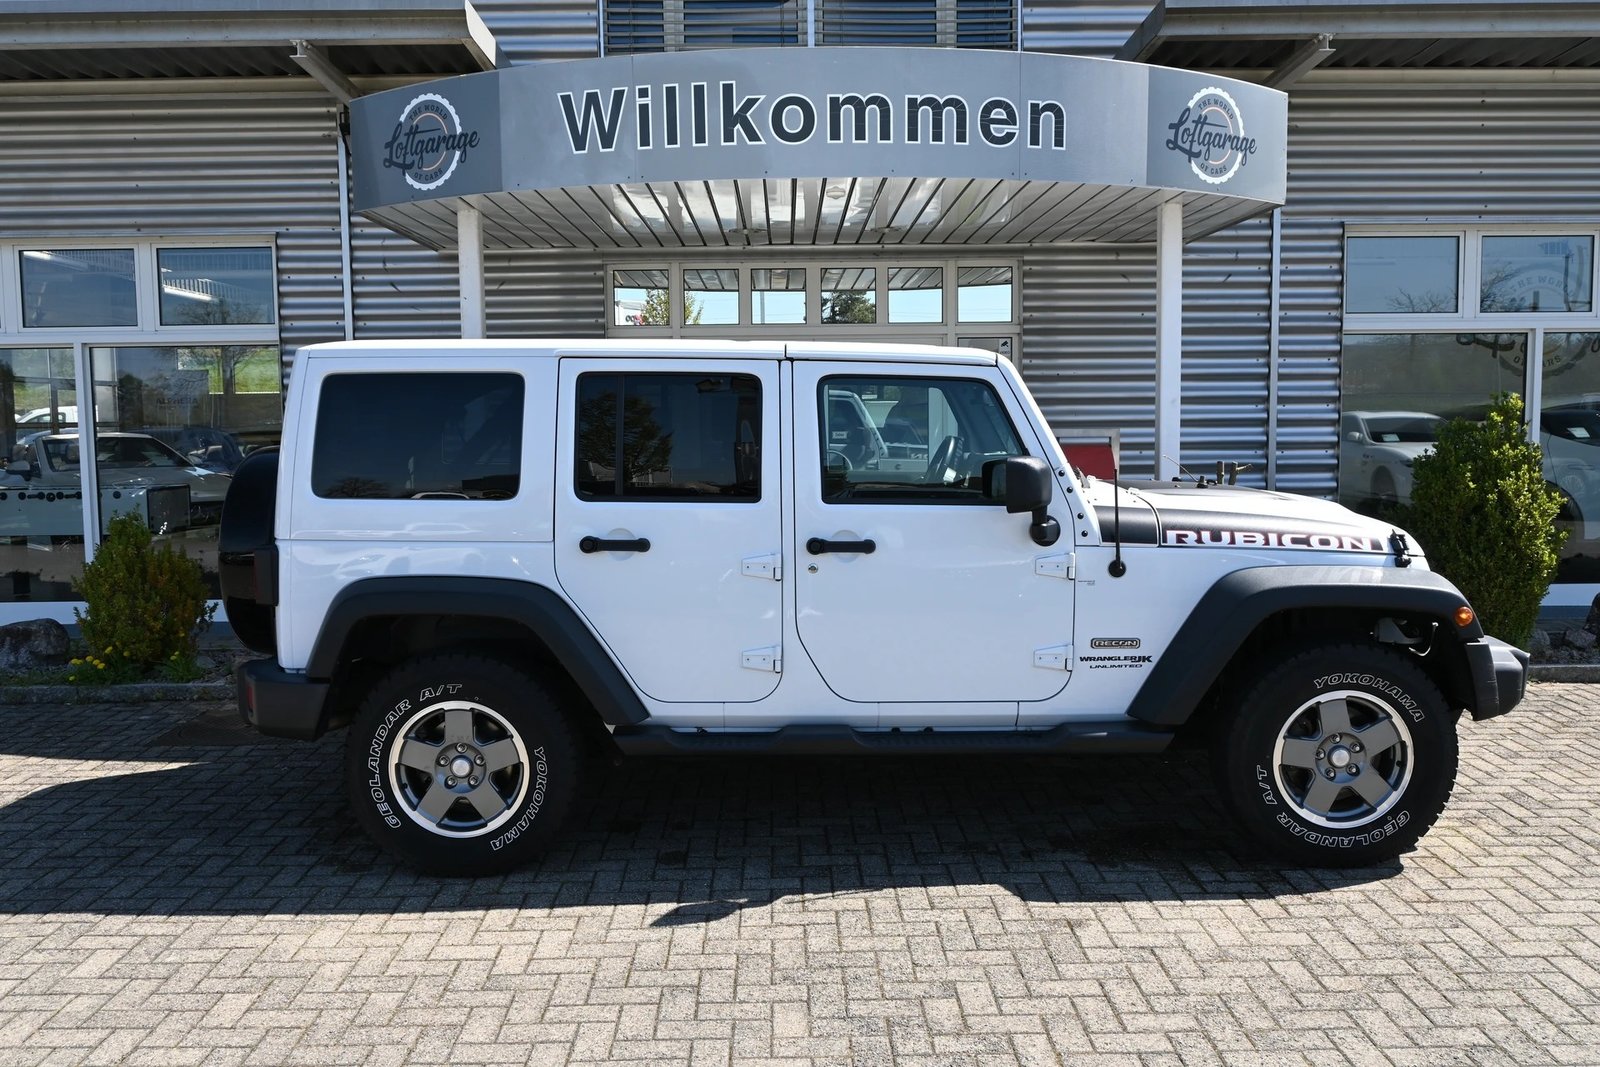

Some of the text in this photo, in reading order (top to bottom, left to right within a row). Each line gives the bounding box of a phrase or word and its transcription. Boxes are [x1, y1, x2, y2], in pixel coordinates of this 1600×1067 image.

[409, 104, 448, 121] THE WORLD
[556, 80, 1067, 154] Willkommen
[1198, 98, 1234, 120] THE WORLD
[383, 121, 480, 176] Loftgarage
[1166, 107, 1257, 167] Loftgarage
[424, 168, 444, 181] CARS
[1200, 162, 1227, 175] OF CARS
[1165, 529, 1372, 551] RUBICON
[1095, 639, 1137, 647] RECON
[1313, 673, 1425, 723] YOKOHAMA
[367, 683, 463, 829] GEOLANDAR A/T
[490, 746, 548, 851] YOKOHAMA
[1256, 764, 1411, 848] GEOLANDAR A/T
